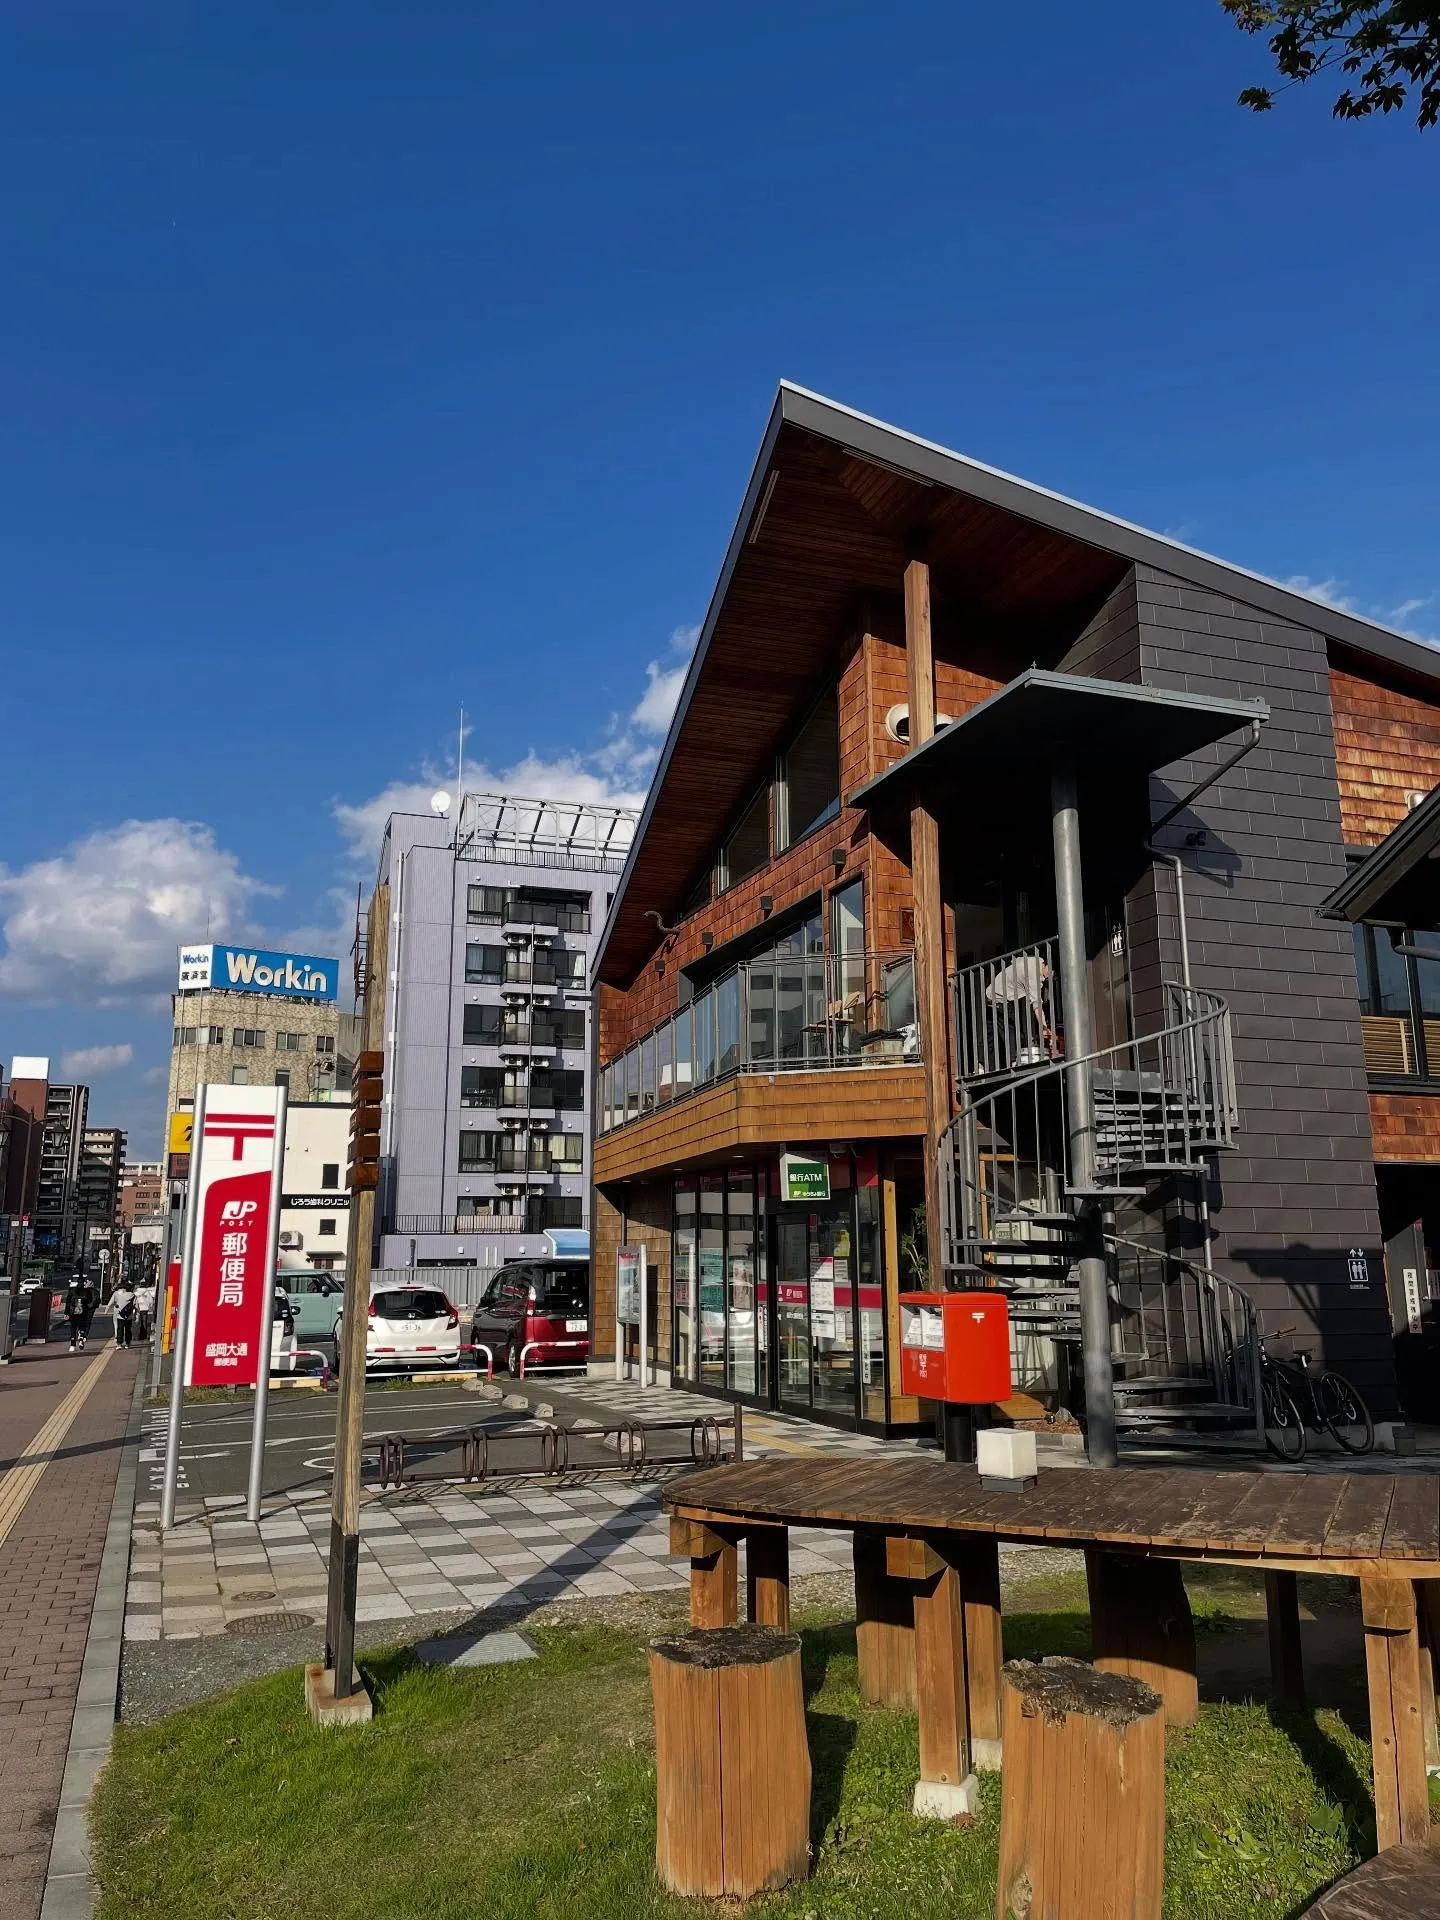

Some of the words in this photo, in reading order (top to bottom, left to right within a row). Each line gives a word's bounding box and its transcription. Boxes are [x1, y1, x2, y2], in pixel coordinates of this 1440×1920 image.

[226, 952, 327, 993] Workin
[790, 1173, 822, 1181] 銀行ATM
[221, 1201, 257, 1219] JP
[291, 1198, 350, 1206] じろう歯科クリニッ
[217, 1232, 248, 1307] 郵便局
